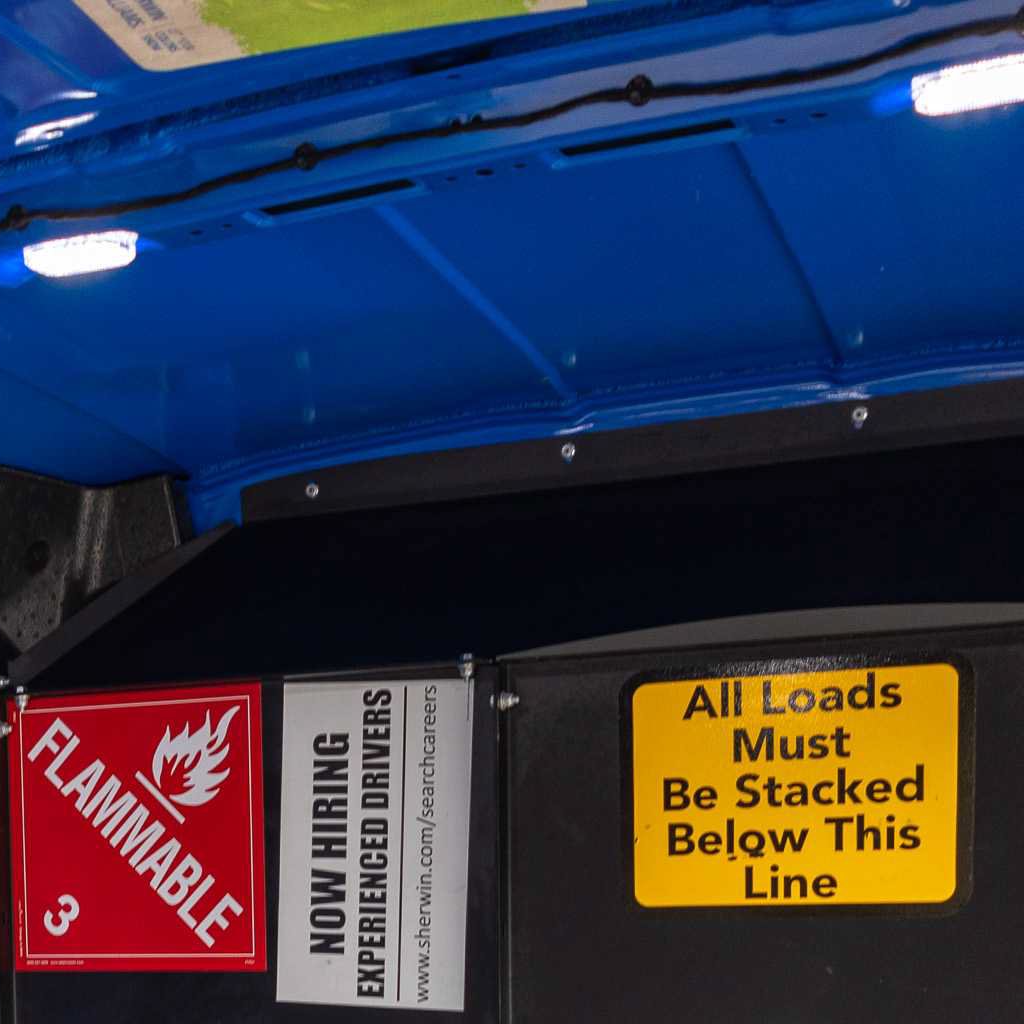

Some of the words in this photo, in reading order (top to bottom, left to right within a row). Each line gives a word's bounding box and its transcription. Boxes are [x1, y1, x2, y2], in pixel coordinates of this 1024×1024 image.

[682, 680, 743, 721] All
[762, 672, 903, 715] Loads
[361, 688, 392, 809] DRIVERS
[733, 726, 851, 762] Must
[312, 732, 350, 859] HIRING
[663, 777, 719, 812] Be
[736, 764, 925, 808] Stacked
[27, 717, 244, 948] FLAMMABLE
[416, 685, 438, 1004] www.sherwin.com/searchcareers
[668, 818, 809, 856] Below
[825, 814, 921, 851] This
[310, 869, 347, 954] NOW
[357, 818, 389, 998] EXPERIENCED
[744, 864, 838, 899] Line
[43, 894, 80, 937] 3
